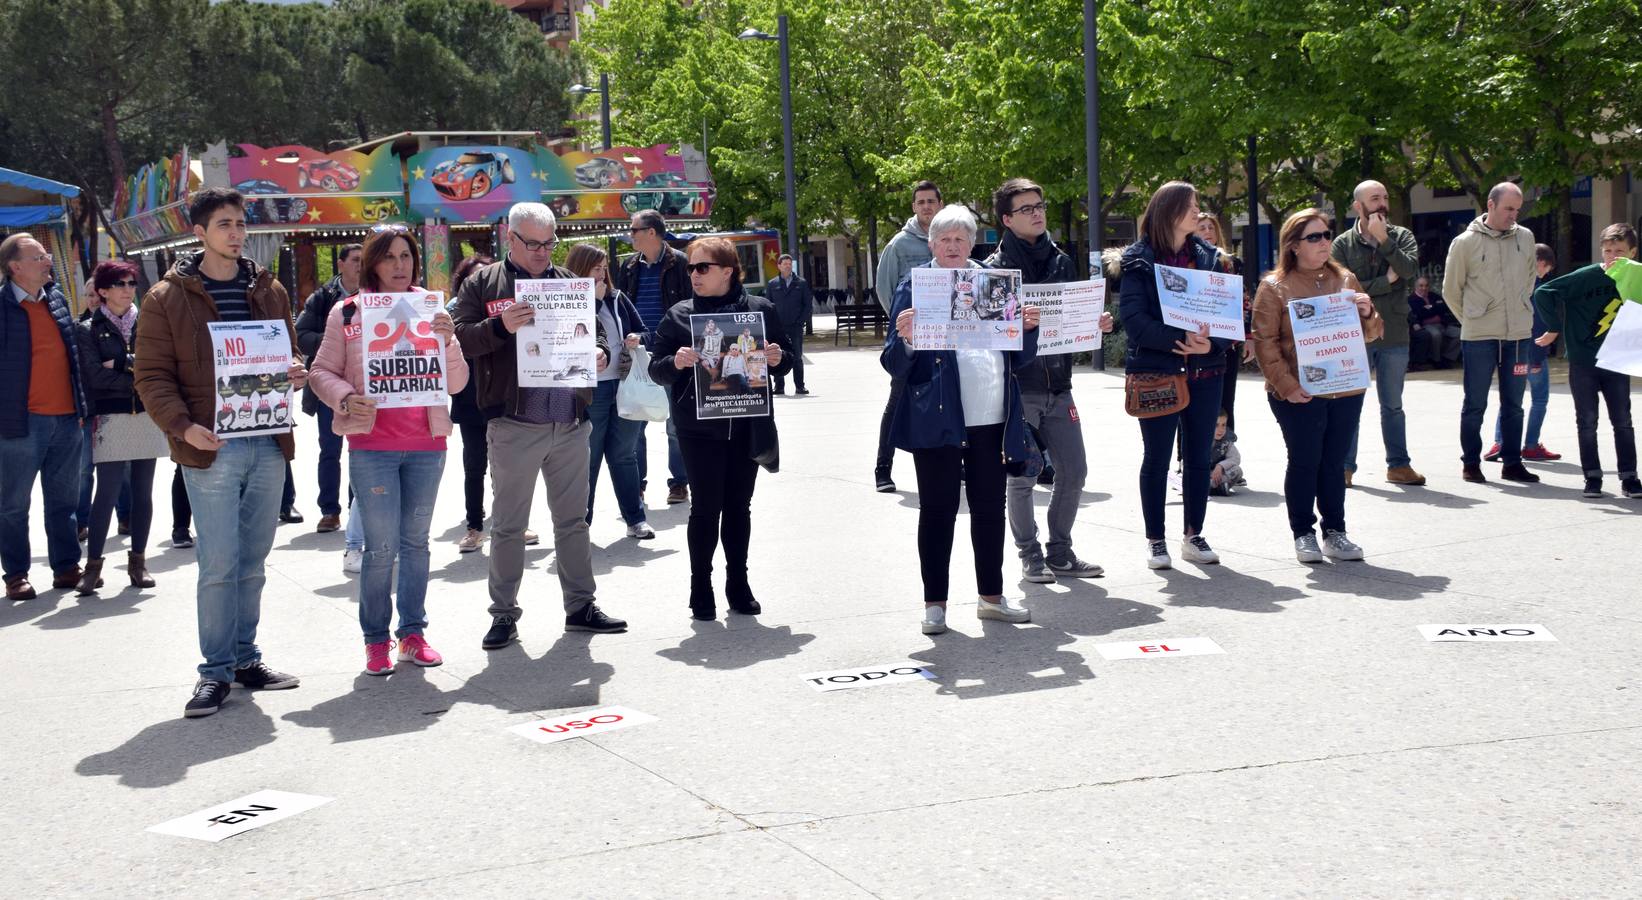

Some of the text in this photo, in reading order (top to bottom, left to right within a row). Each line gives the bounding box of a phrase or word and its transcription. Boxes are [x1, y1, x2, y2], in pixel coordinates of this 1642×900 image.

[570, 281, 590, 290] USO
[956, 282, 973, 291] USO
[522, 292, 588, 302] SON VÍCTIMAS,
[1025, 290, 1062, 298] BLINDAR
[363, 295, 393, 306] USO
[536, 302, 588, 310] CULPABLES
[733, 314, 756, 323] USO
[344, 325, 362, 337] US
[913, 324, 943, 333] Trabajo
[1298, 329, 1360, 346] TODO EL AÑO ES
[224, 337, 246, 357] NO
[934, 342, 957, 350] Digna
[1315, 345, 1348, 358] #1MAYO
[223, 357, 229, 365] la
[230, 354, 266, 366] precariedad
[267, 353, 288, 363] laboral
[368, 357, 443, 377] SUBIDA
[368, 377, 444, 394] SALARIAL
[705, 394, 736, 403] Rompamos
[741, 392, 762, 401] etiqueta
[715, 399, 765, 408] PRECARIEDAD
[1437, 627, 1536, 637] AÑO
[1138, 644, 1181, 654] EL
[806, 667, 922, 686] TODO
[538, 714, 624, 734] USO
[207, 804, 279, 826] EN
